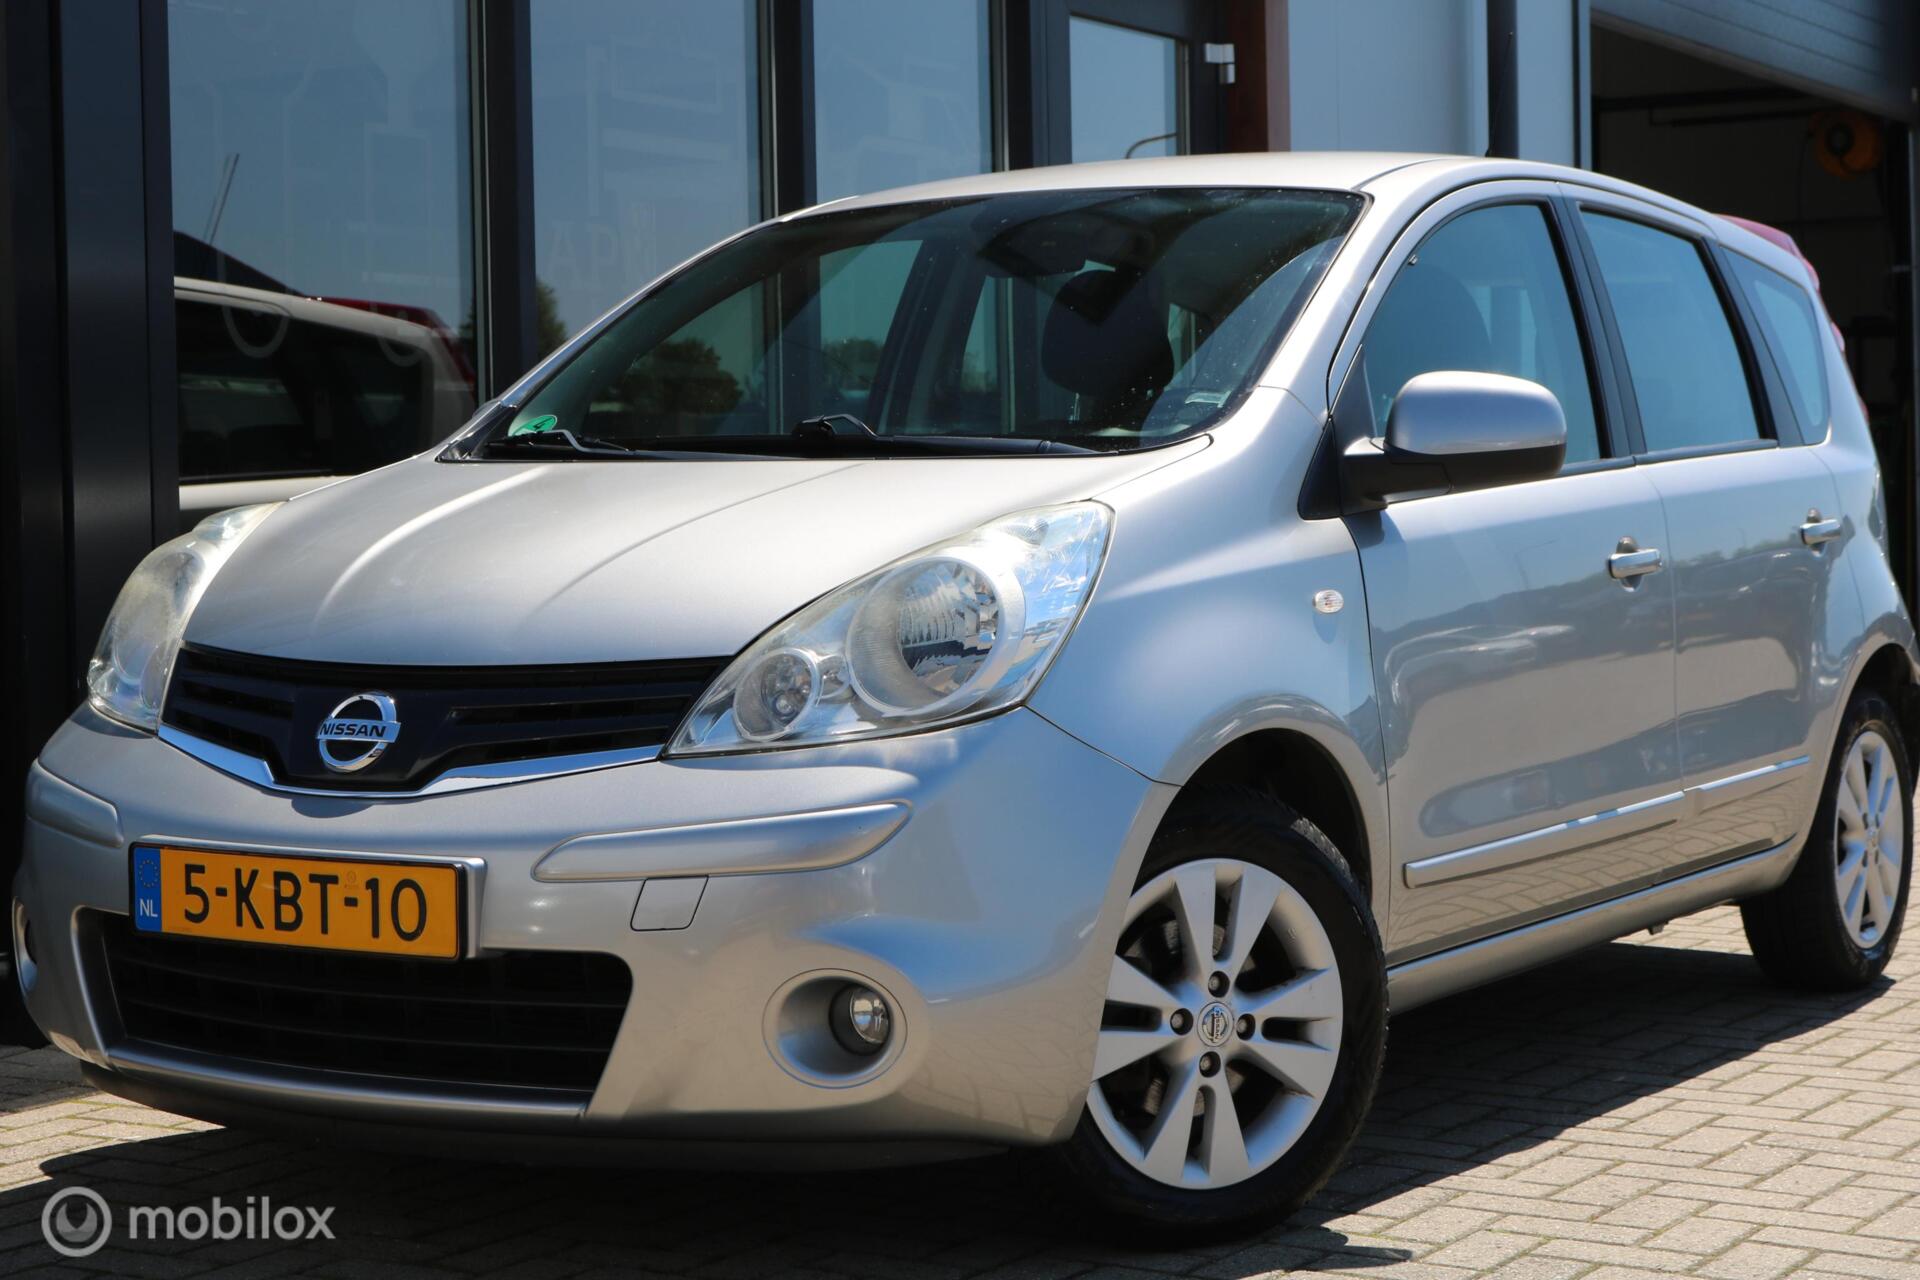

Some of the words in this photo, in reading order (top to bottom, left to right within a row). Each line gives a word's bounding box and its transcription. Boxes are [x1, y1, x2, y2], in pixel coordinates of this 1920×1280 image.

[319, 723, 386, 738] NISSAN
[140, 898, 158, 917] NL
[184, 863, 427, 942] 5-KBT-10
